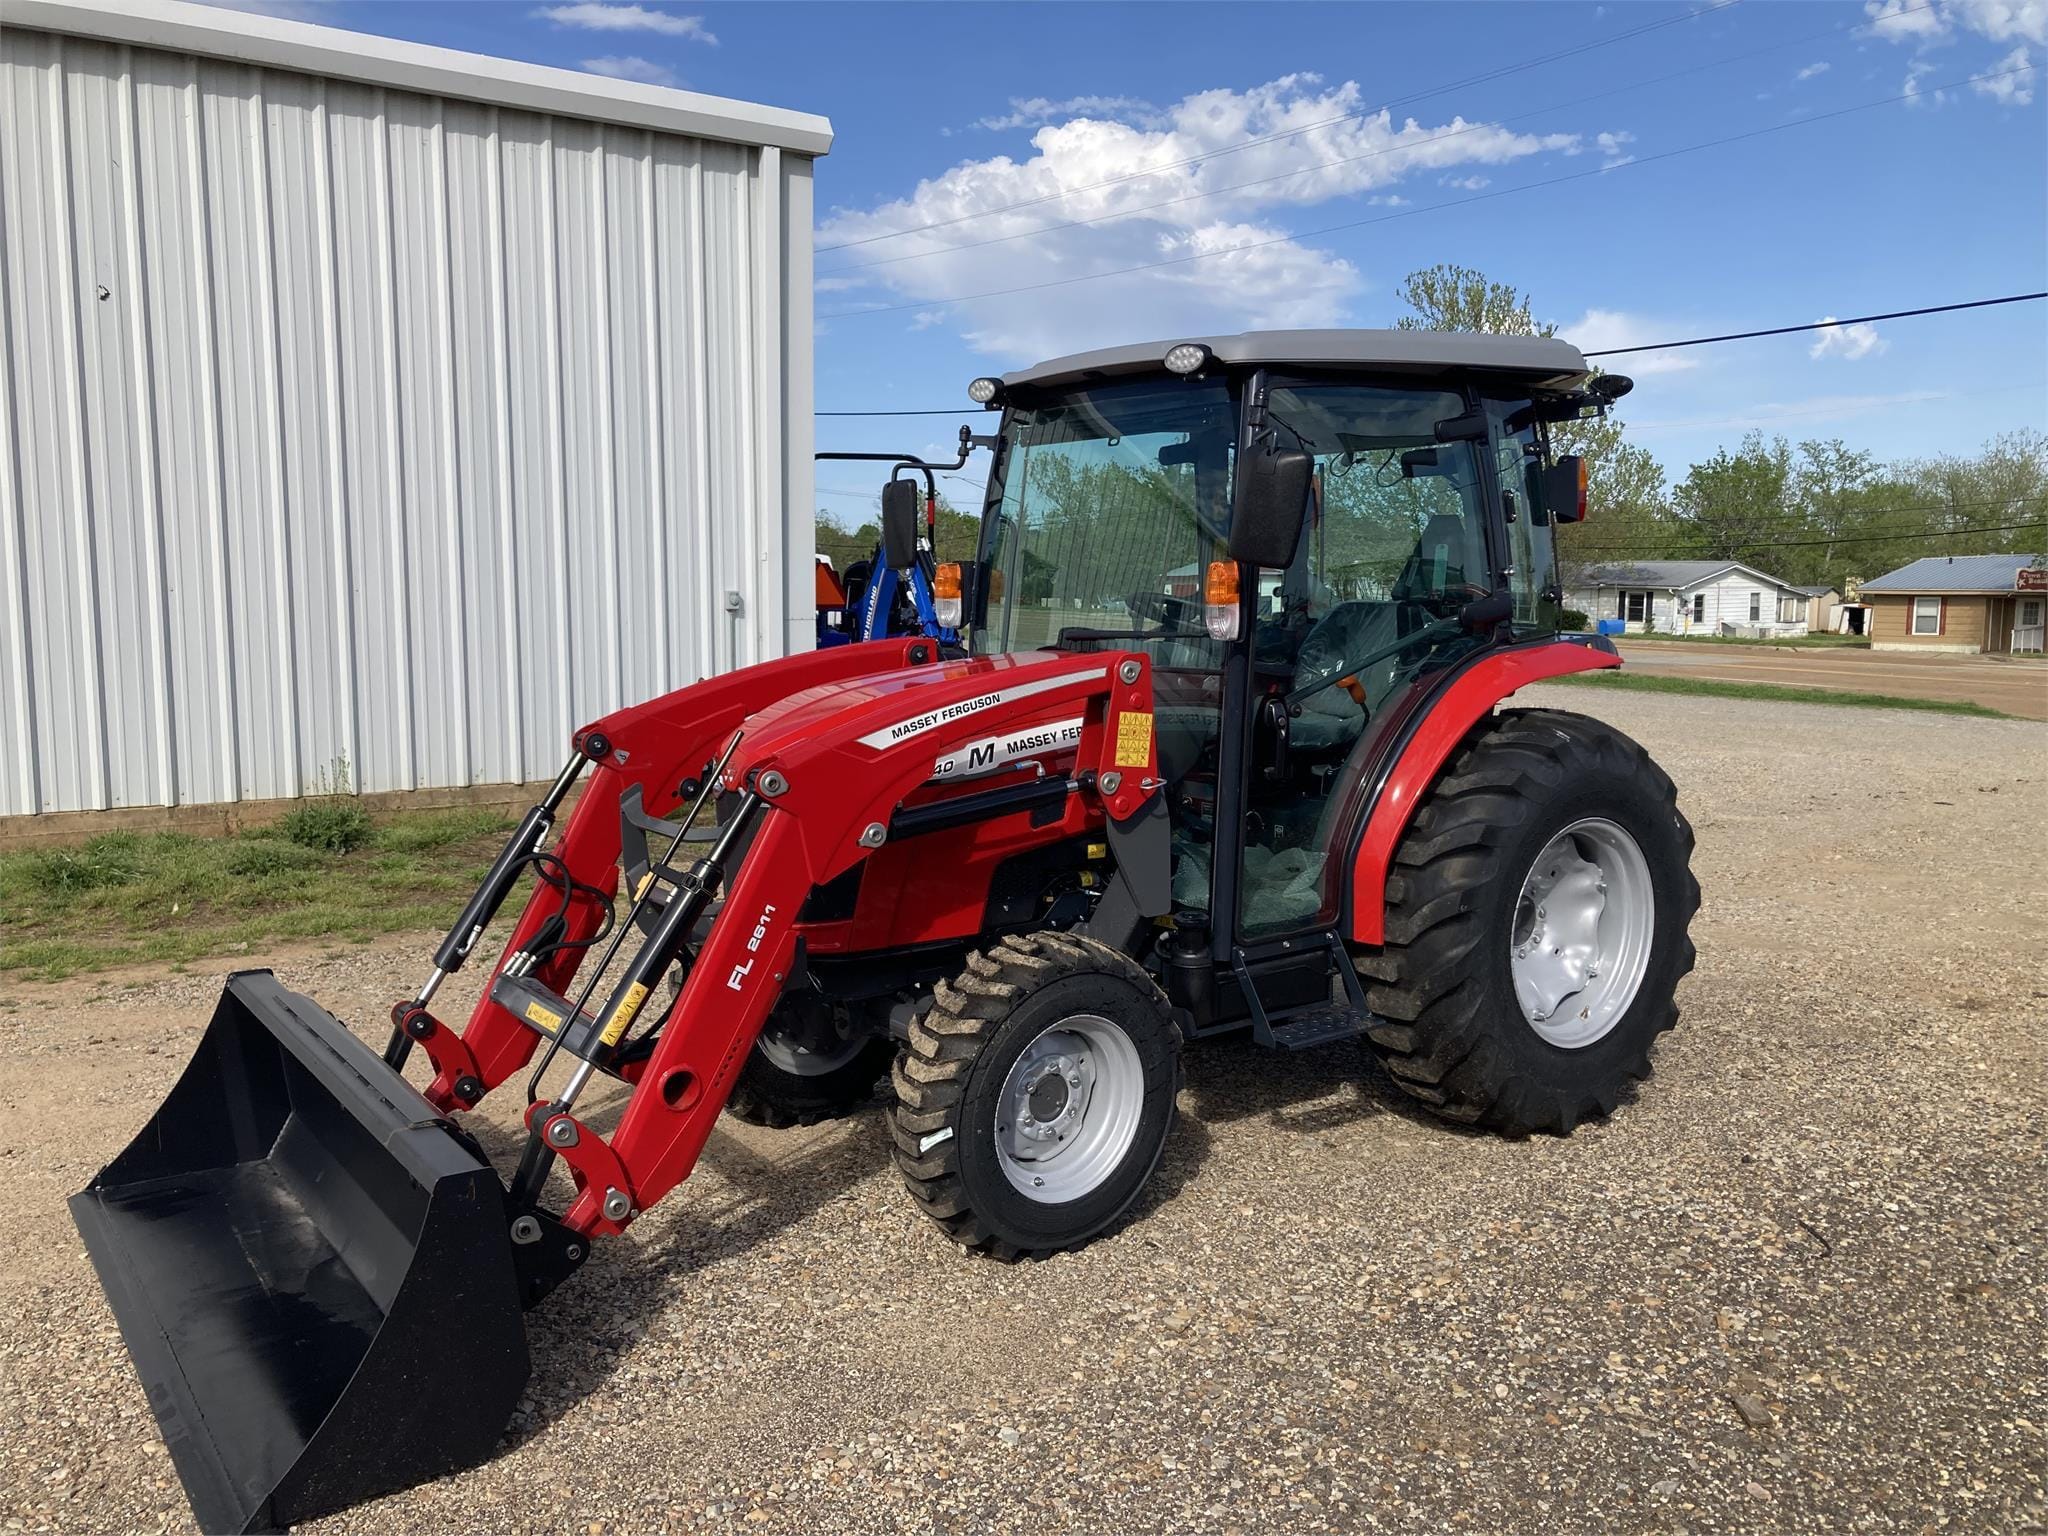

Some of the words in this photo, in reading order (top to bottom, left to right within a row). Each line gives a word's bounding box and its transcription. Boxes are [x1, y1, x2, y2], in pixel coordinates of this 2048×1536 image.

[865, 585, 878, 629] HOLLAND
[891, 713, 938, 739] MASSEY
[942, 693, 1001, 720] FERGUSON
[968, 742, 995, 770] M
[1006, 731, 1057, 755] MASSEY
[727, 958, 754, 991] FL
[747, 904, 776, 952] 2611
